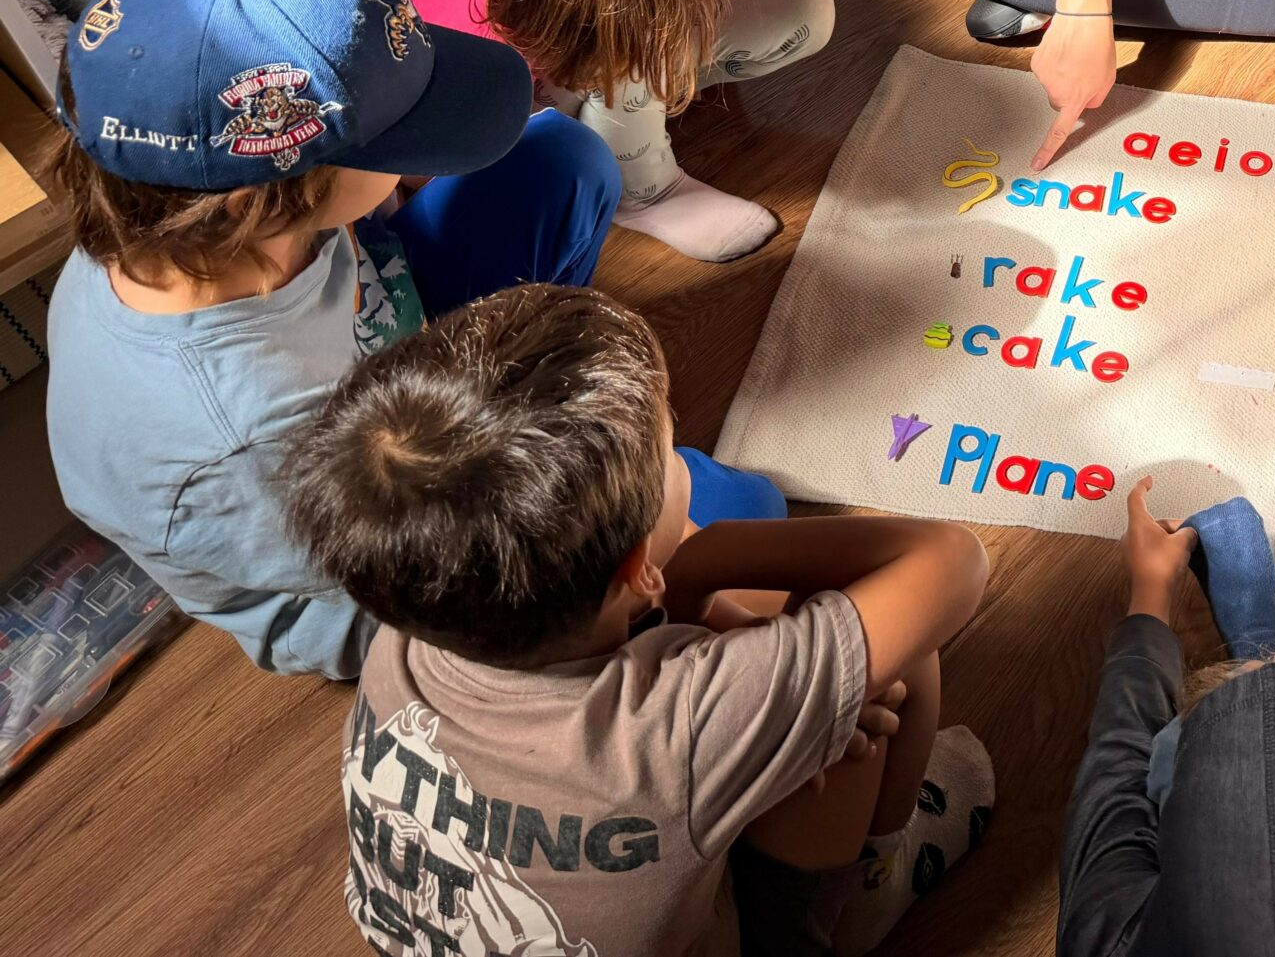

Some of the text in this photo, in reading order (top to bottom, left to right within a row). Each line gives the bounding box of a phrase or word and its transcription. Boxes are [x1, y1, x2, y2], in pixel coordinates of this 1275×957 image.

[86, 11, 112, 29] NHL
[293, 120, 319, 142] YEAR
[1006, 171, 1177, 225] snake
[982, 255, 1148, 312] rake
[961, 314, 1130, 384] cake
